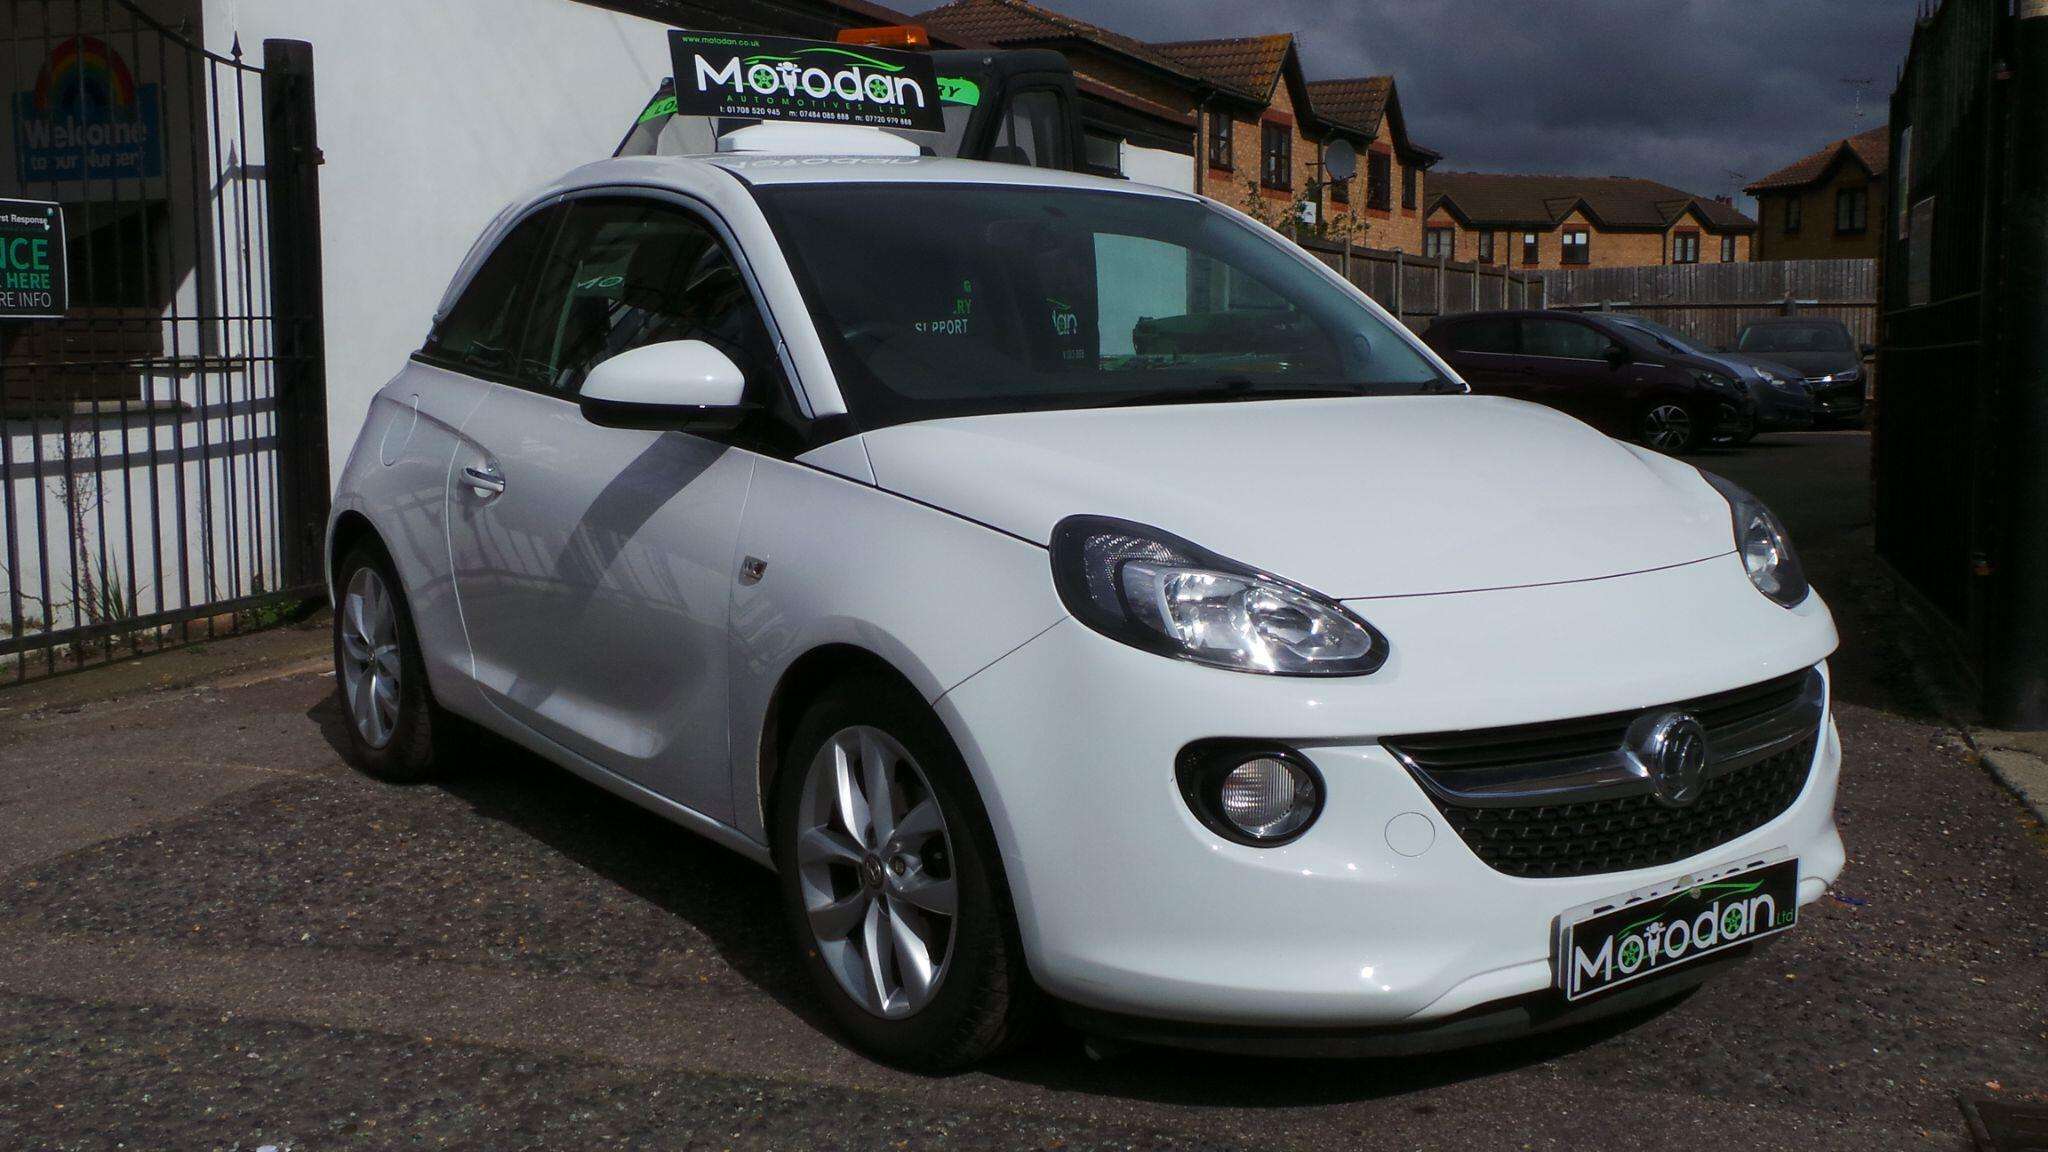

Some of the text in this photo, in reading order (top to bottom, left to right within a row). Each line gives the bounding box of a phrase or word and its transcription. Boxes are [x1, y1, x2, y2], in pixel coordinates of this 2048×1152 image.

[682, 36, 760, 47] www.motodan.co.uk
[694, 54, 925, 107] Motodan
[727, 94, 905, 115] AUTOMOTIVES LTD
[25, 115, 147, 148] Welcome
[11, 214, 48, 226] Response
[7, 272, 51, 289] HERE
[20, 292, 52, 308] INFO
[1573, 893, 1794, 992] Motodan Ltd
